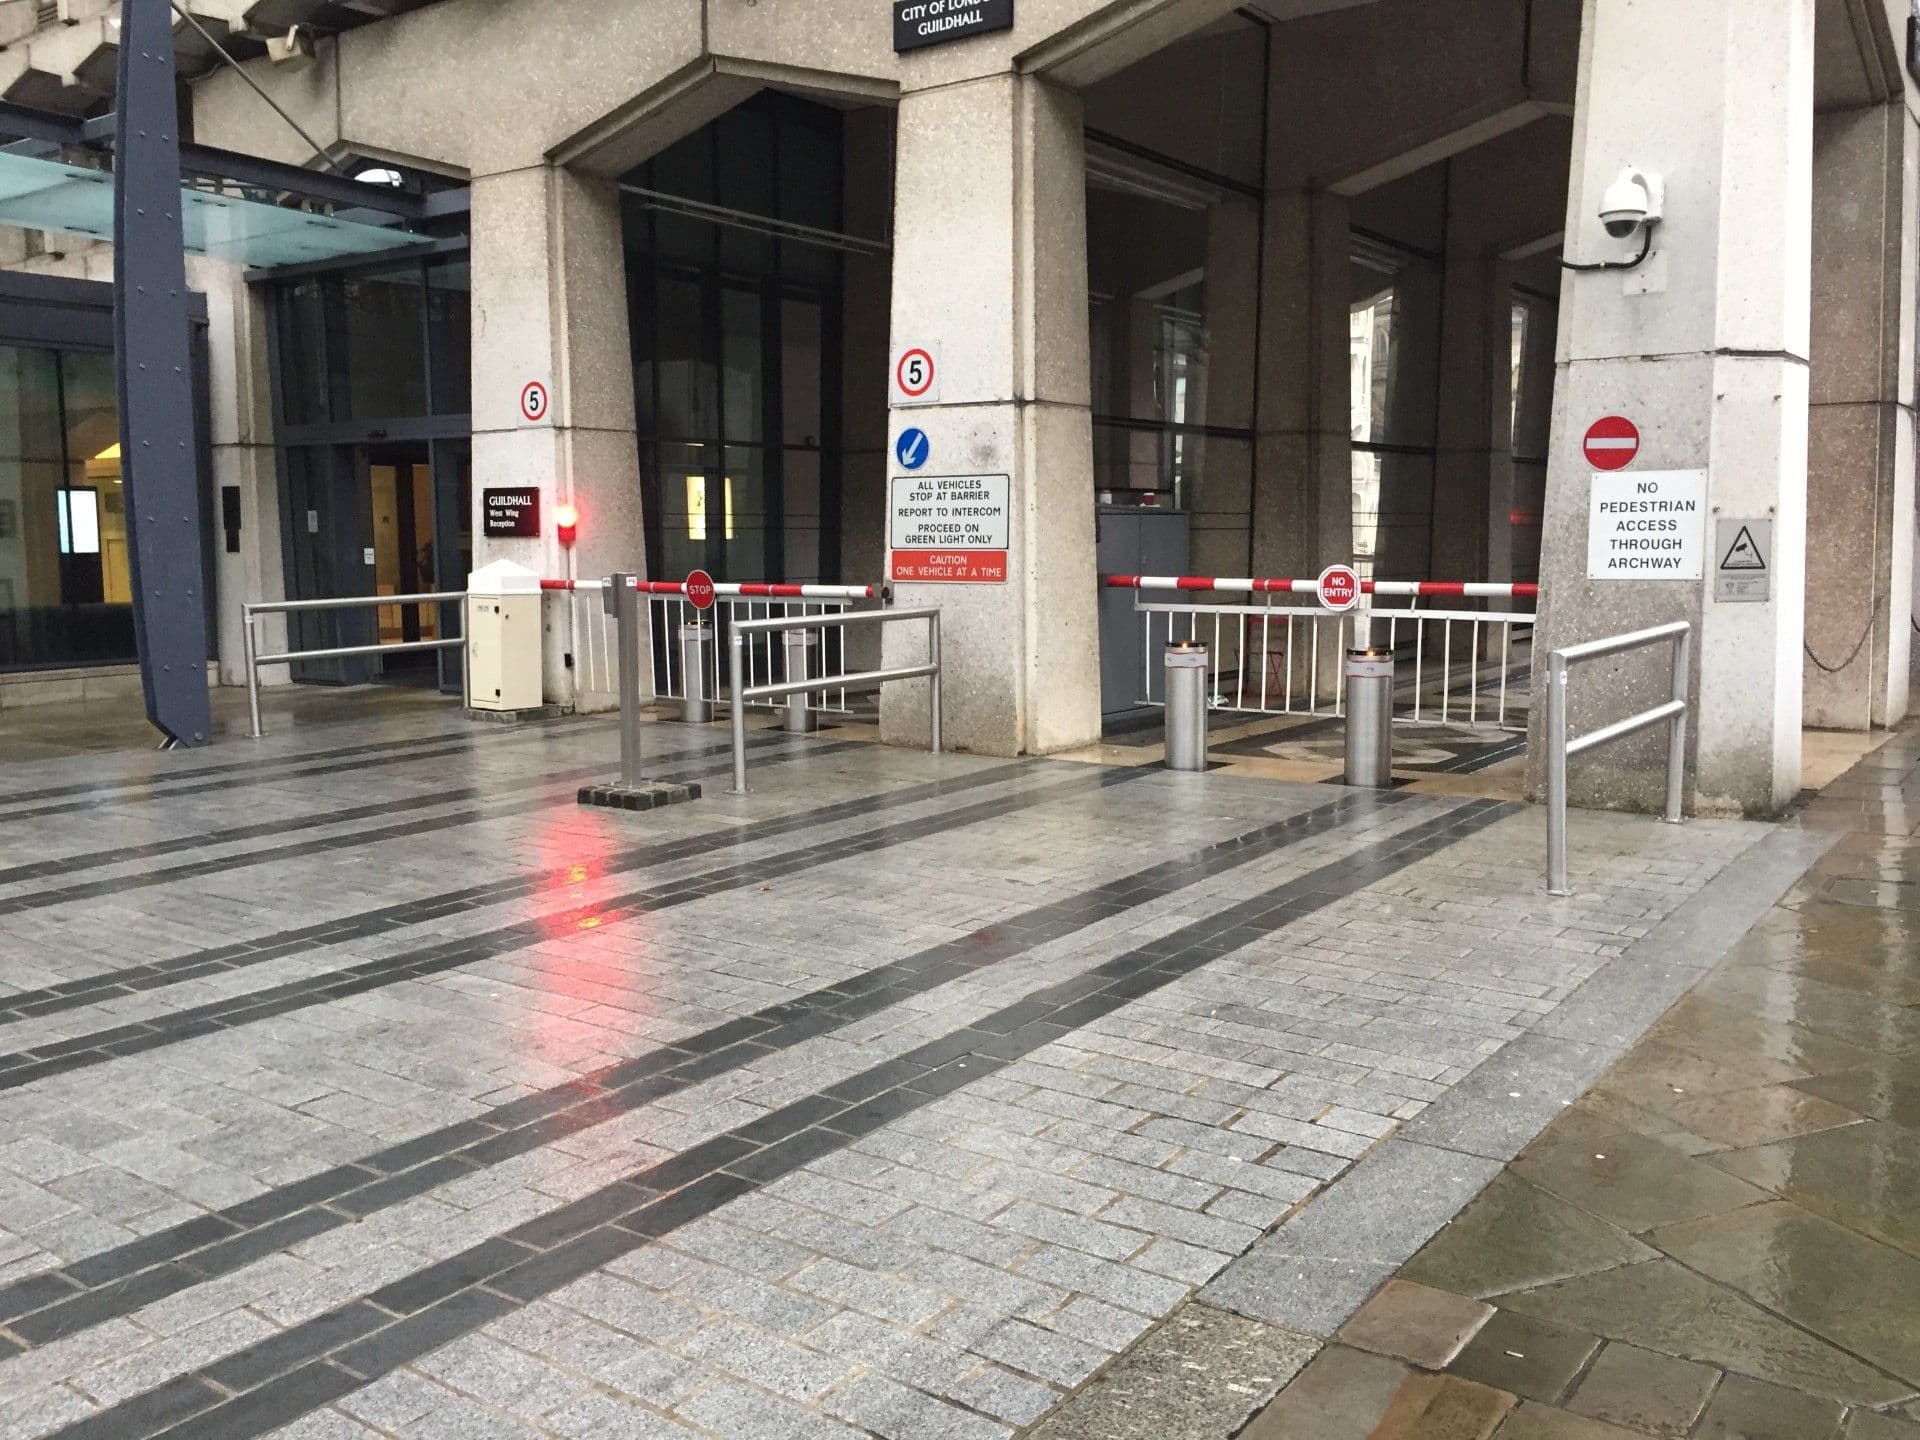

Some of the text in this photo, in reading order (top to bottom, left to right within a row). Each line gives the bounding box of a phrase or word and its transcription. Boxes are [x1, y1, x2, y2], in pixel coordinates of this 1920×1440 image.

[901, 0, 989, 21] CITY OF LON
[918, 10, 983, 35] GUILDHALL
[909, 360, 922, 384] 5
[530, 391, 539, 411] 5
[918, 480, 981, 490] ALL VEHICLES
[1637, 482, 1658, 493] NO
[489, 495, 532, 506] GUILDHALL
[909, 491, 990, 501] STOP AT BARRIER
[1600, 500, 1696, 513] PEDESTRIAN
[490, 509, 503, 517] West
[898, 507, 1001, 517] REPORT TO INTERCOM
[918, 524, 979, 533] PROCEED ON
[1616, 520, 1677, 531] ACCESS
[905, 535, 992, 544] GREEN LIGHT ONLY
[1609, 538, 1682, 550] THROUGH
[929, 555, 967, 565] CAUTION
[1608, 557, 1682, 569] ARCHWAY
[896, 567, 1002, 577] ONE VEHICLE AT A TIME
[1331, 577, 1346, 586] NO
[690, 585, 711, 595] STOP
[1324, 587, 1353, 597] ENTRY
